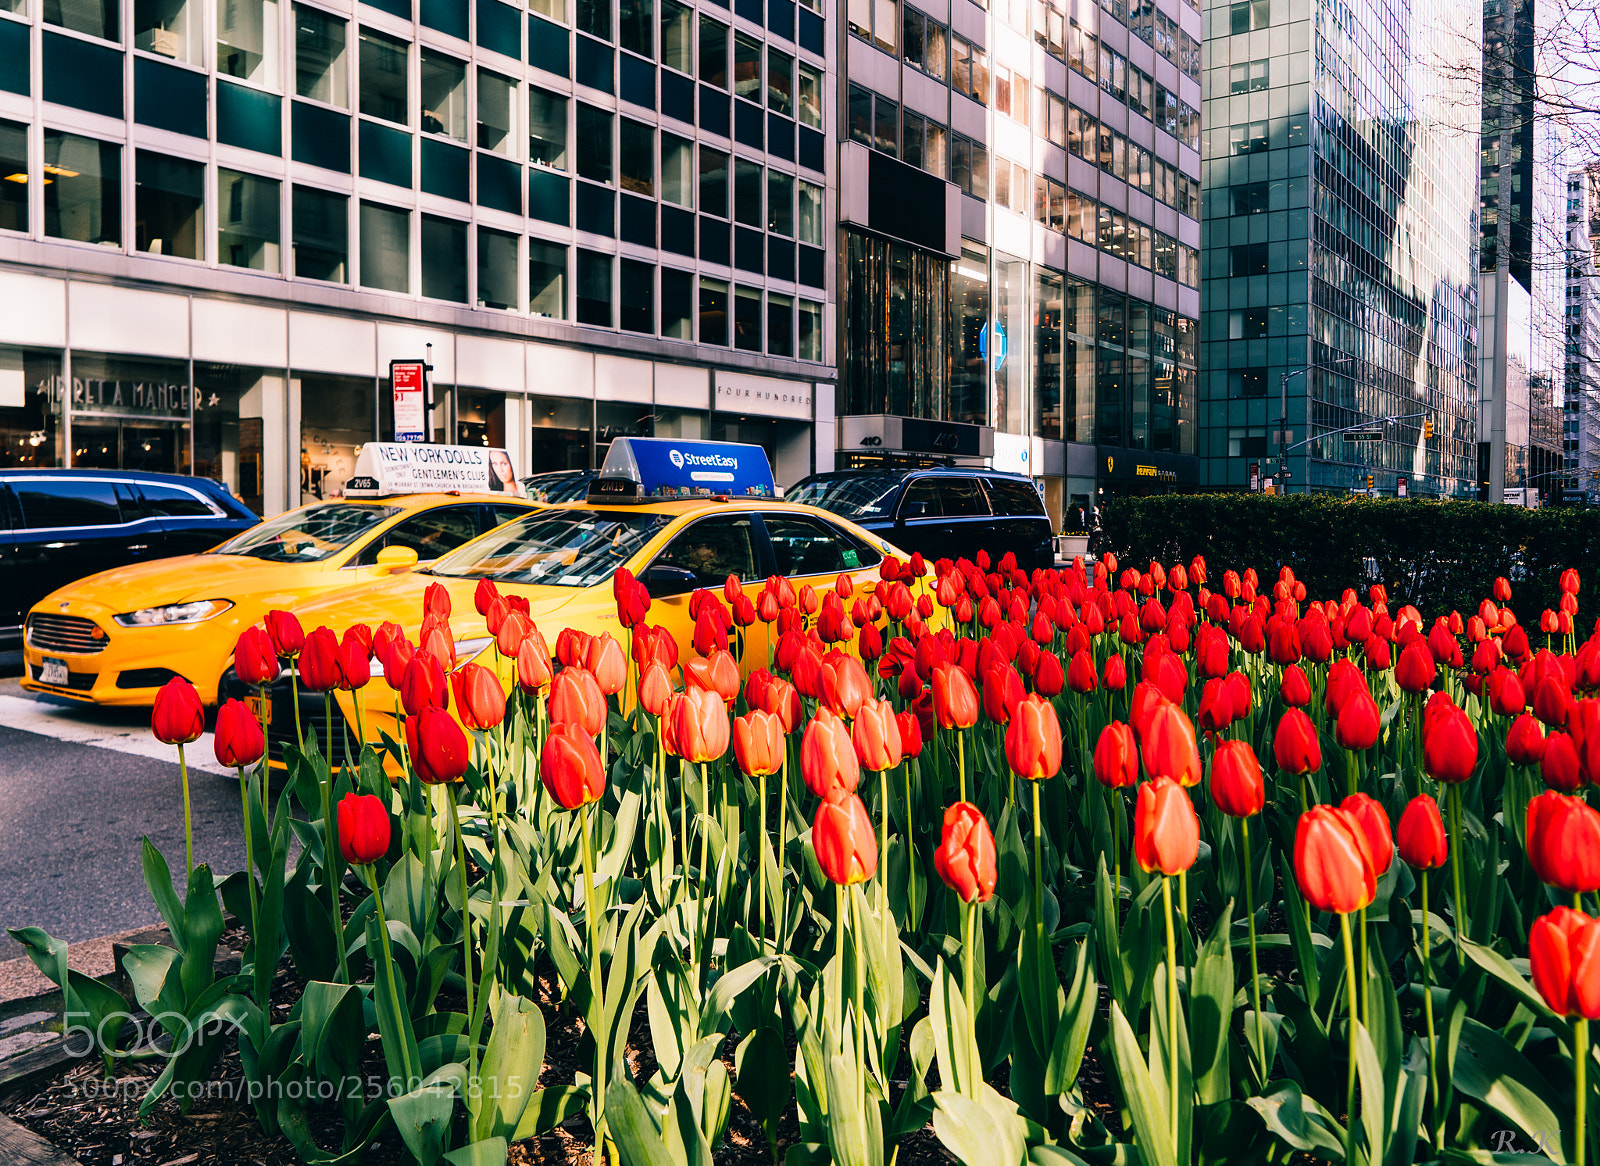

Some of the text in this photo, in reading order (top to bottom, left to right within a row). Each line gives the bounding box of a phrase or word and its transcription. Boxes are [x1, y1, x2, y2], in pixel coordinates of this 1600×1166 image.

[113, 380, 123, 405] A
[132, 382, 203, 410] MANGER
[718, 386, 811, 404] FOUR HUNDRED
[860, 436, 882, 446] 410
[933, 432, 959, 449] 410
[379, 447, 482, 465] NEW YORK DOLLS
[684, 453, 738, 469] StreetEasy
[412, 469, 486, 481] GENTLEMEN'S CLUB
[354, 479, 371, 488] 2V65
[601, 480, 625, 491] 2M19
